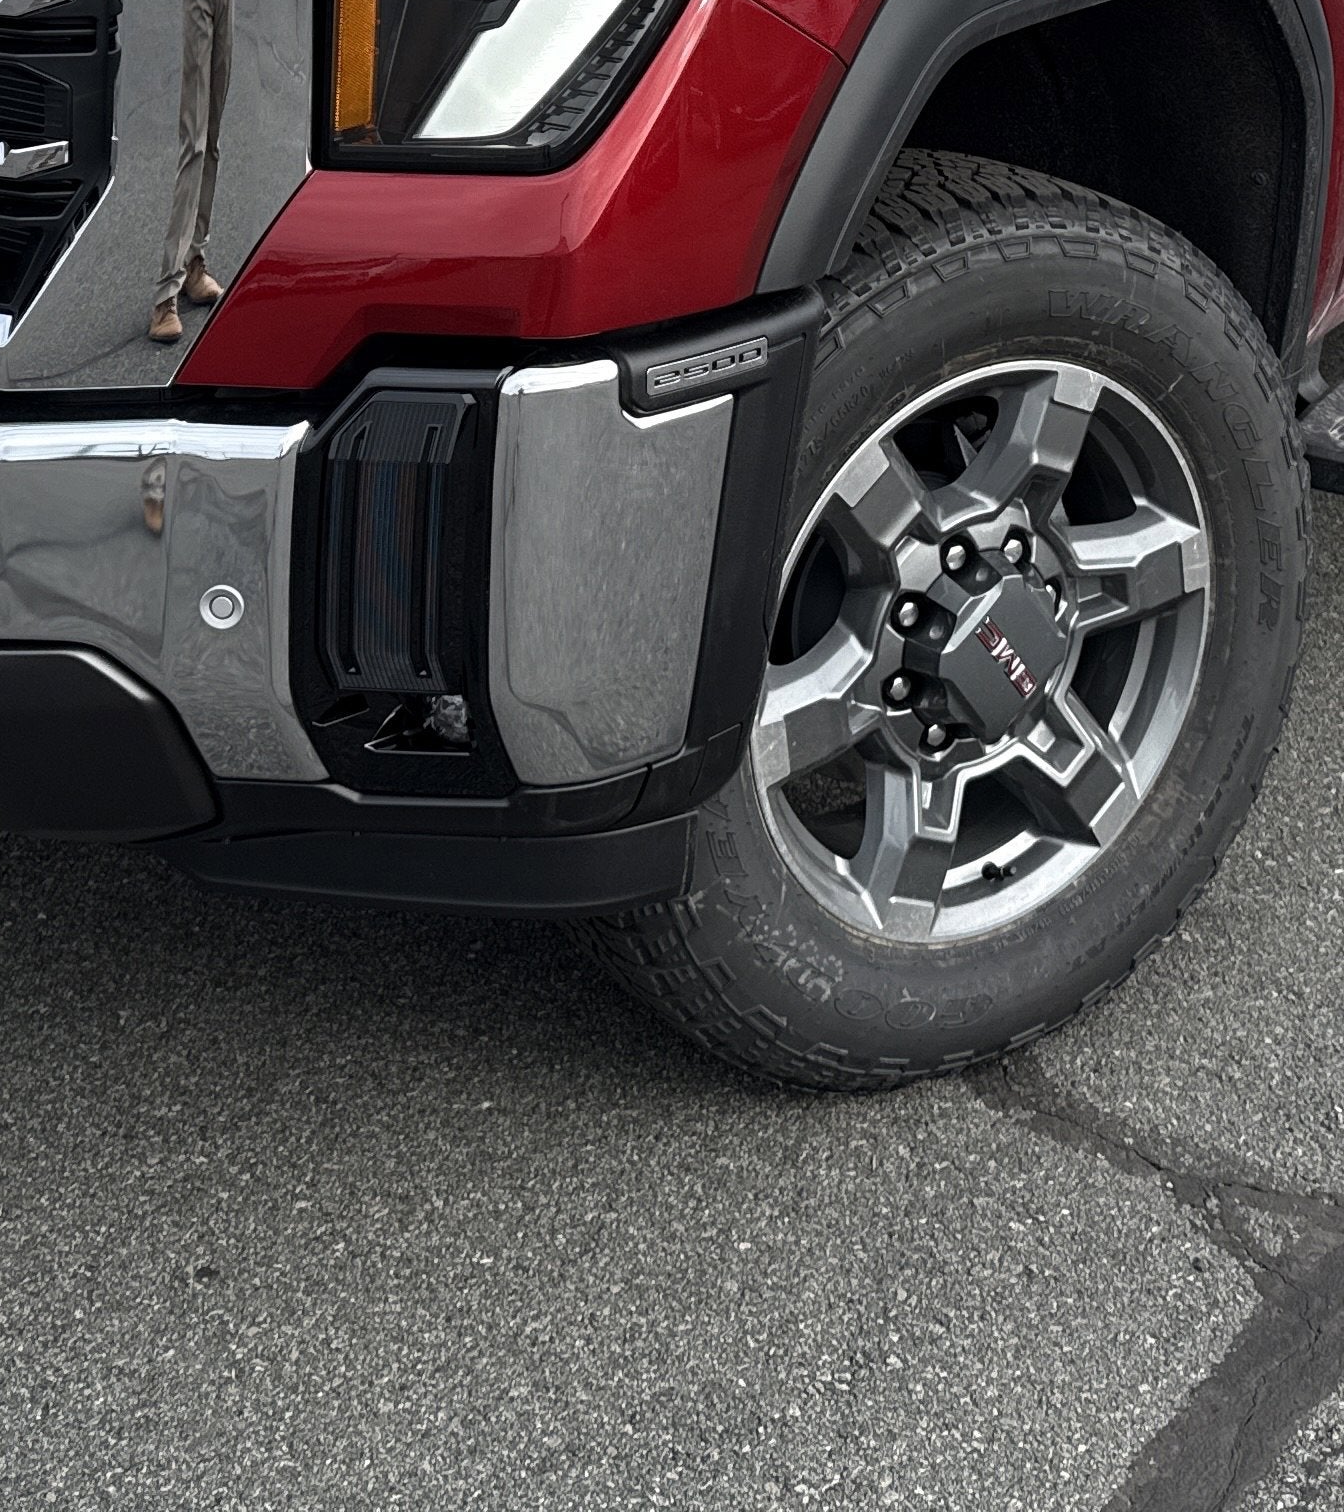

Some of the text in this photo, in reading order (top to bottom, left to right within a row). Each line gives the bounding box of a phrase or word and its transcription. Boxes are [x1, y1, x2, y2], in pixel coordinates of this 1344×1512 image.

[654, 347, 762, 389] 2500
[1048, 289, 1284, 632] WRANGLER
[975, 615, 1037, 698] GMC
